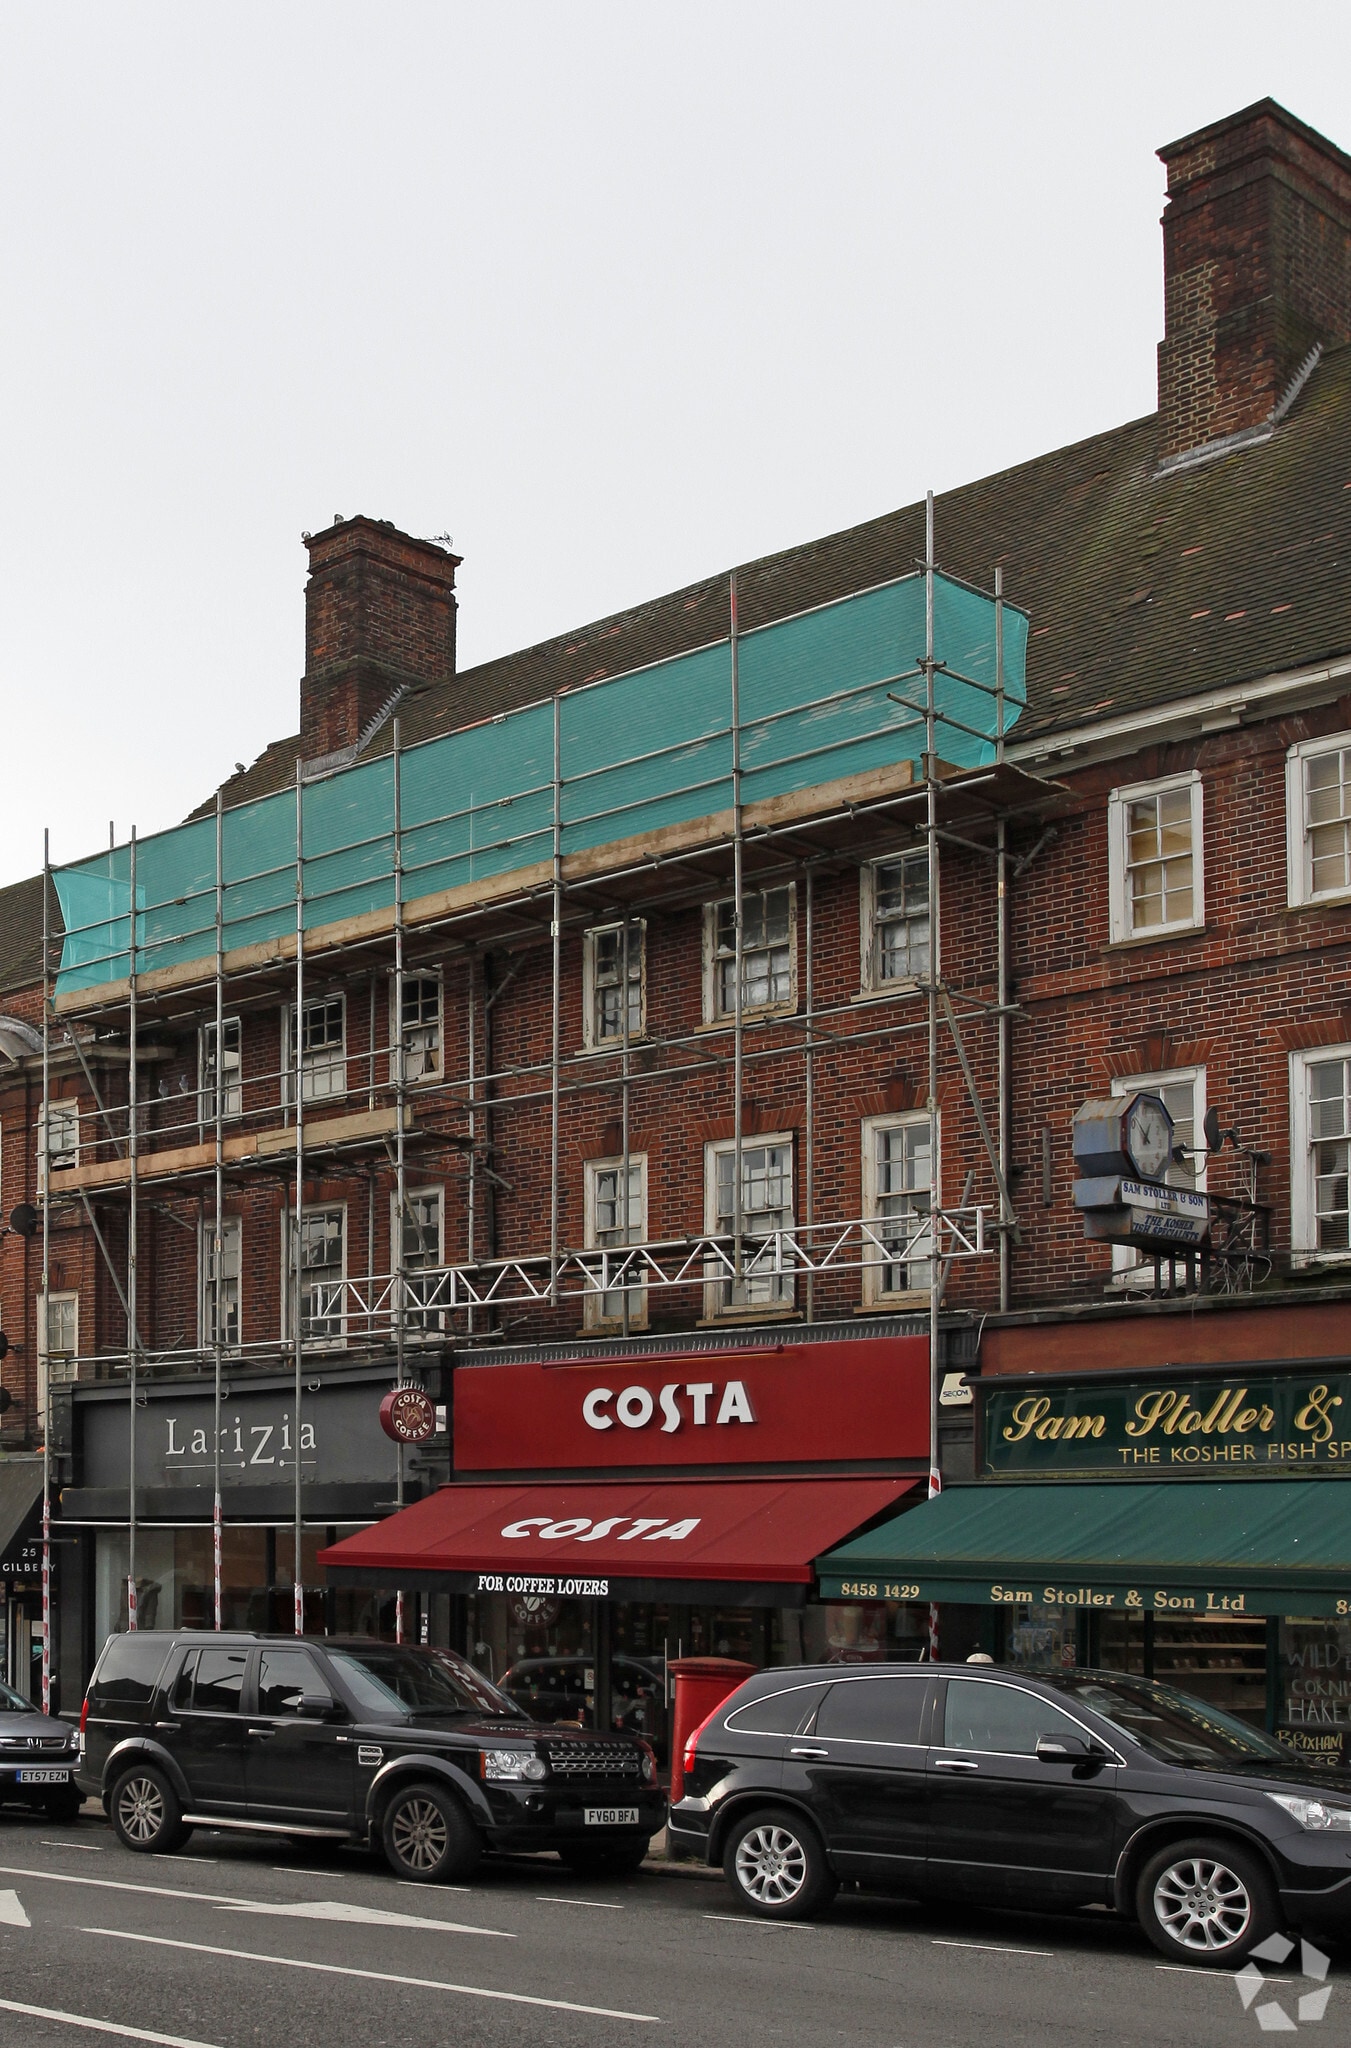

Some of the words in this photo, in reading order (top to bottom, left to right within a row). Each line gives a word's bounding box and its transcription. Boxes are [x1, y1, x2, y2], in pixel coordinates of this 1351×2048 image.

[1123, 1182, 1141, 1195] SAM
[1143, 1186, 1178, 1202] STOLLER
[1189, 1195, 1204, 1207] SON
[1160, 1202, 1171, 1210] LTD
[1133, 1222, 1151, 1234] ISH
[1152, 1227, 1199, 1240] SPECIALISTS
[1145, 1214, 1164, 1227] THE
[1164, 1218, 1195, 1231] KOSHER
[398, 1394, 427, 1409] COSTA
[943, 1389, 969, 1398] SECOM
[583, 1381, 754, 1433] COSTA
[1003, 1397, 1107, 1441] Sam
[1125, 1390, 1275, 1437] Stoller
[1294, 1385, 1343, 1442] &
[395, 1419, 430, 1438] COFFEE
[1119, 1447, 1160, 1464] THE
[1171, 1444, 1257, 1463] KOSHER
[1268, 1442, 1316, 1460] FISH
[501, 1516, 702, 1542] COSTA
[22, 1548, 37, 1557] 25
[2, 1563, 56, 1572] GILBEY
[477, 1575, 504, 1591] FOR
[506, 1576, 555, 1595] COFFEE
[557, 1578, 609, 1596] LOVERS
[841, 1582, 878, 1597] 8458
[884, 1584, 920, 1599] 1429
[990, 1585, 1033, 1603] Sam
[1042, 1587, 1115, 1606] Stoller
[1124, 1590, 1143, 1607] &
[1153, 1591, 1195, 1609] Son
[1206, 1592, 1246, 1611] Ltd
[514, 1602, 556, 1624] COFFEE
[1287, 1643, 1341, 1668] WILD
[1291, 1678, 1351, 1697] CORNI
[1288, 1698, 1345, 1724] HAKE
[550, 1741, 588, 1749] LAND
[594, 1741, 633, 1750] ROVER
[1275, 1729, 1344, 1750] BRIXHAM
[22, 1771, 47, 1781] ET57
[589, 1810, 616, 1822] FV60
[618, 1810, 636, 1822] BFA
